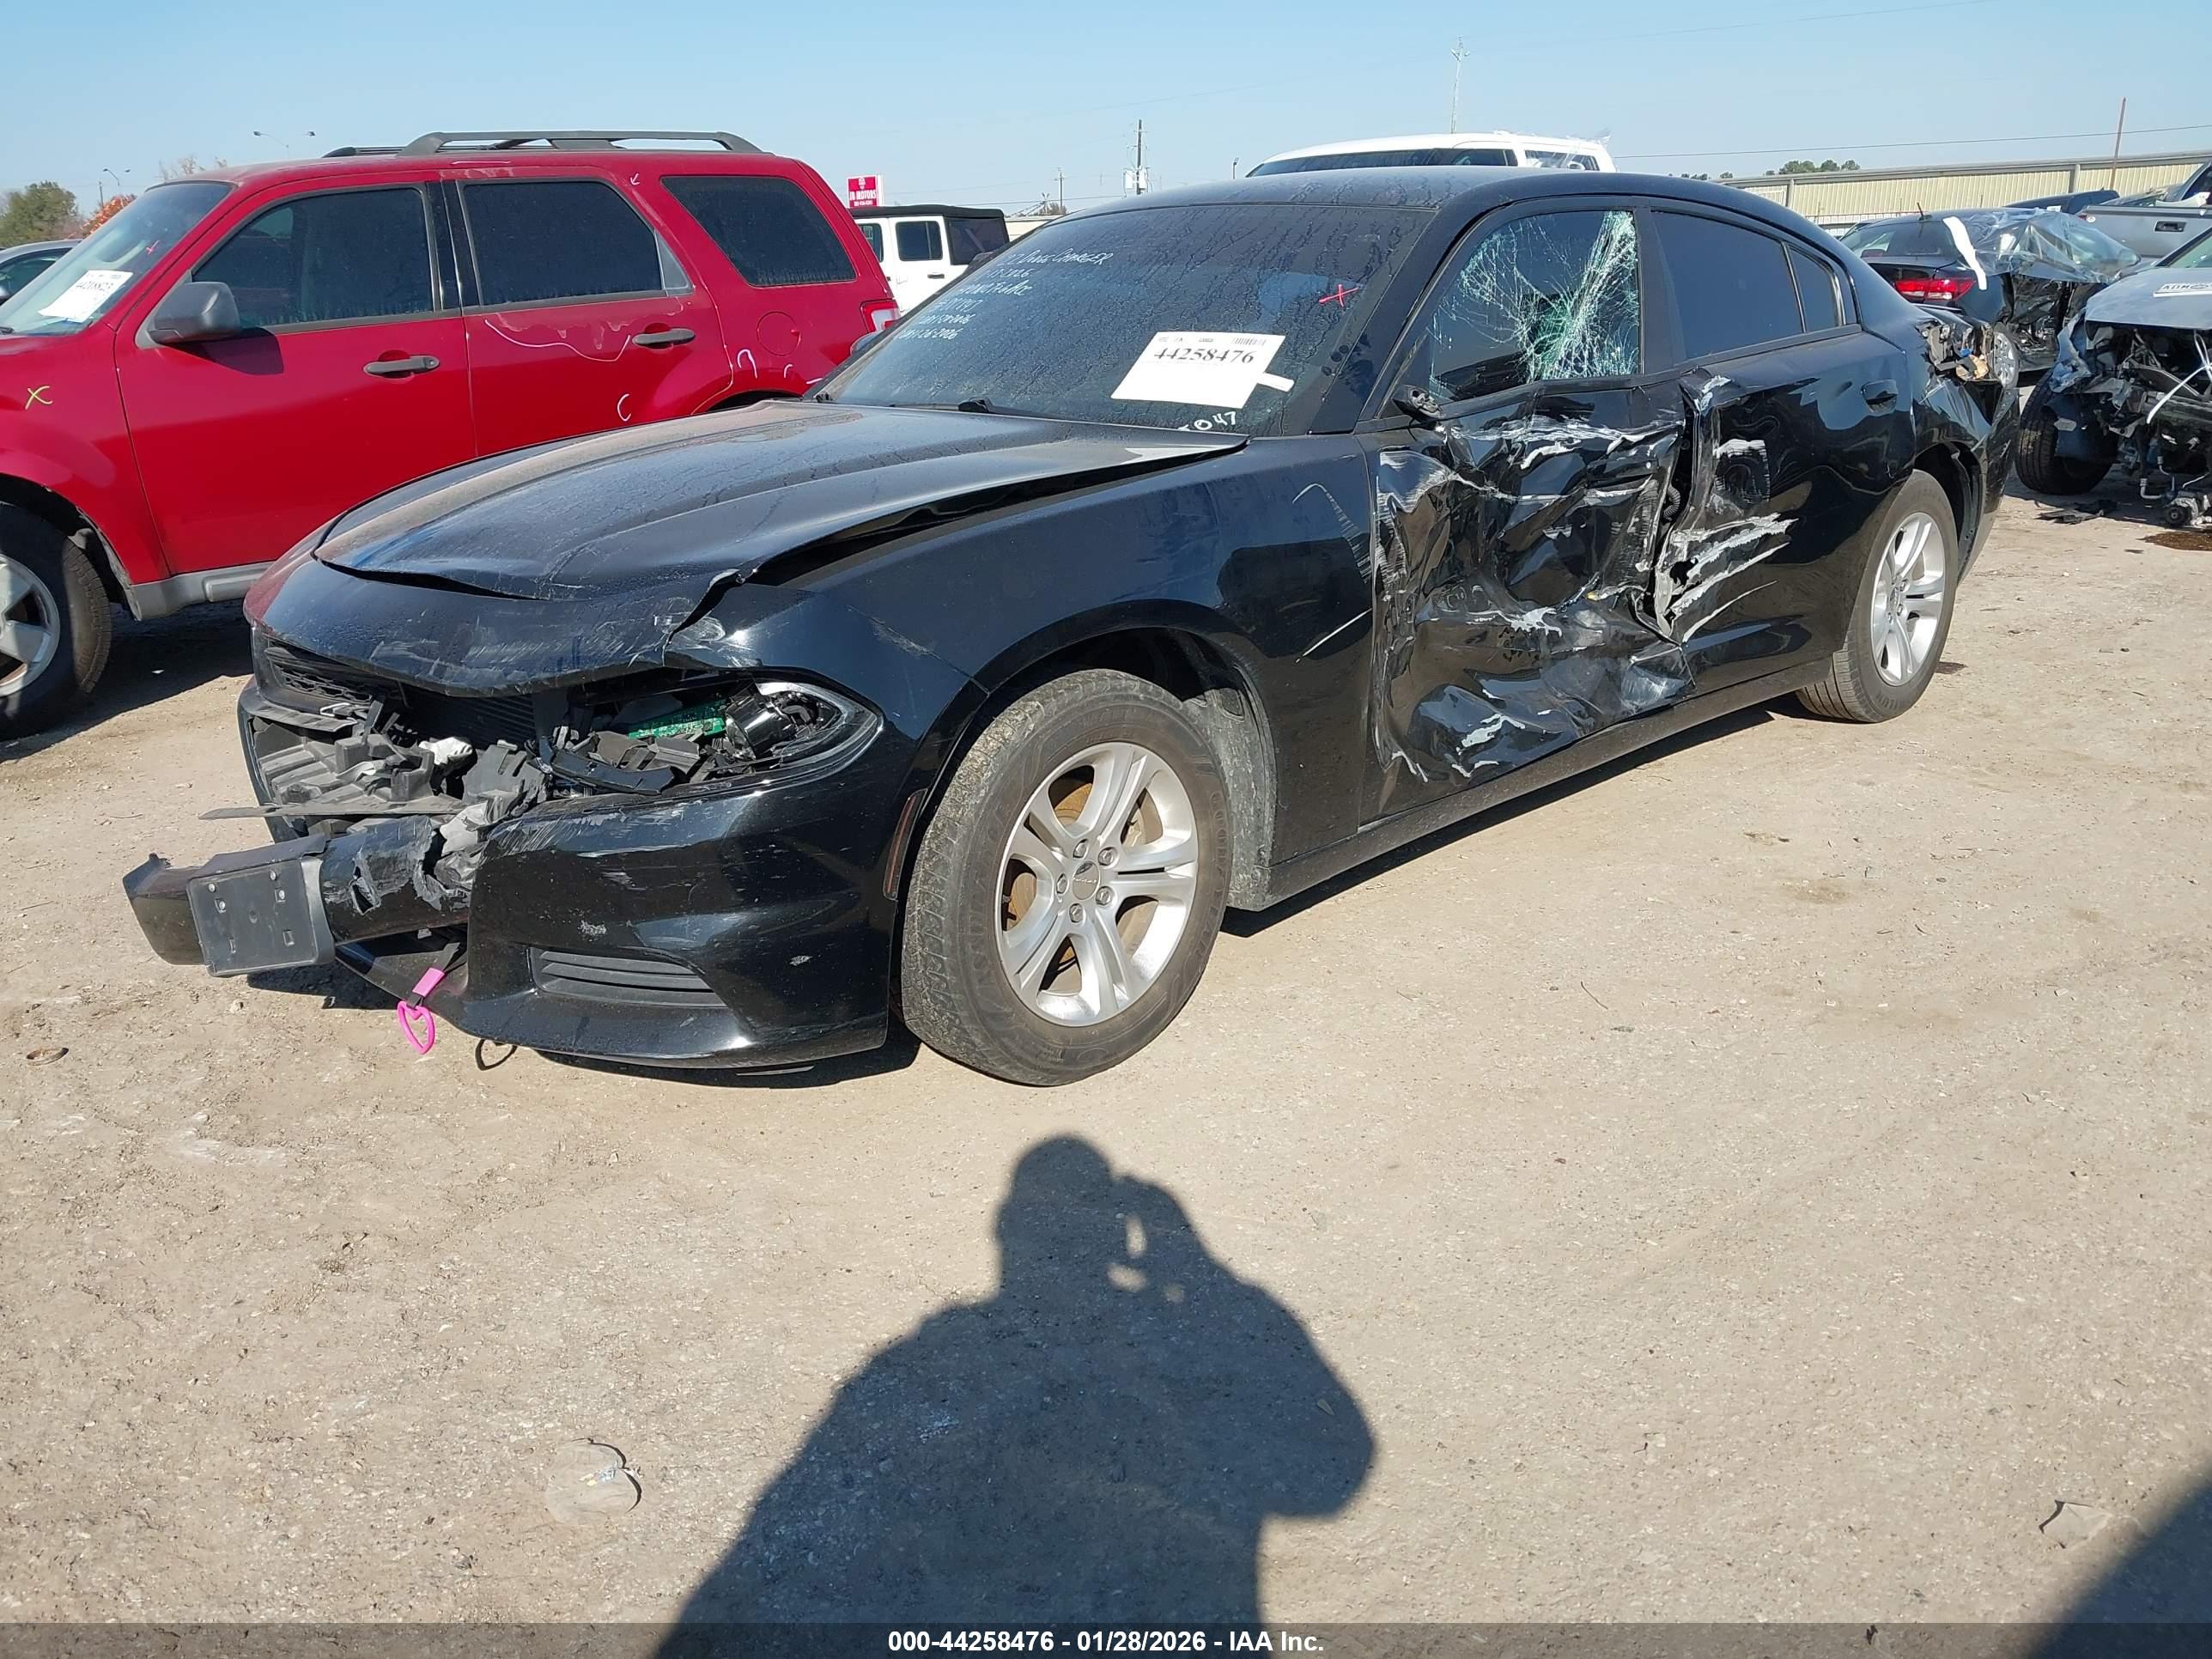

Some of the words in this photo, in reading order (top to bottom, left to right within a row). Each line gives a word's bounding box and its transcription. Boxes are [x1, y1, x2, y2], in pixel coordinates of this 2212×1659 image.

[856, 189, 877, 200] MOTORS
[1052, 247, 1114, 265] CHARGER
[1153, 347, 1258, 364] 44258476
[1177, 410, 1237, 432] 047
